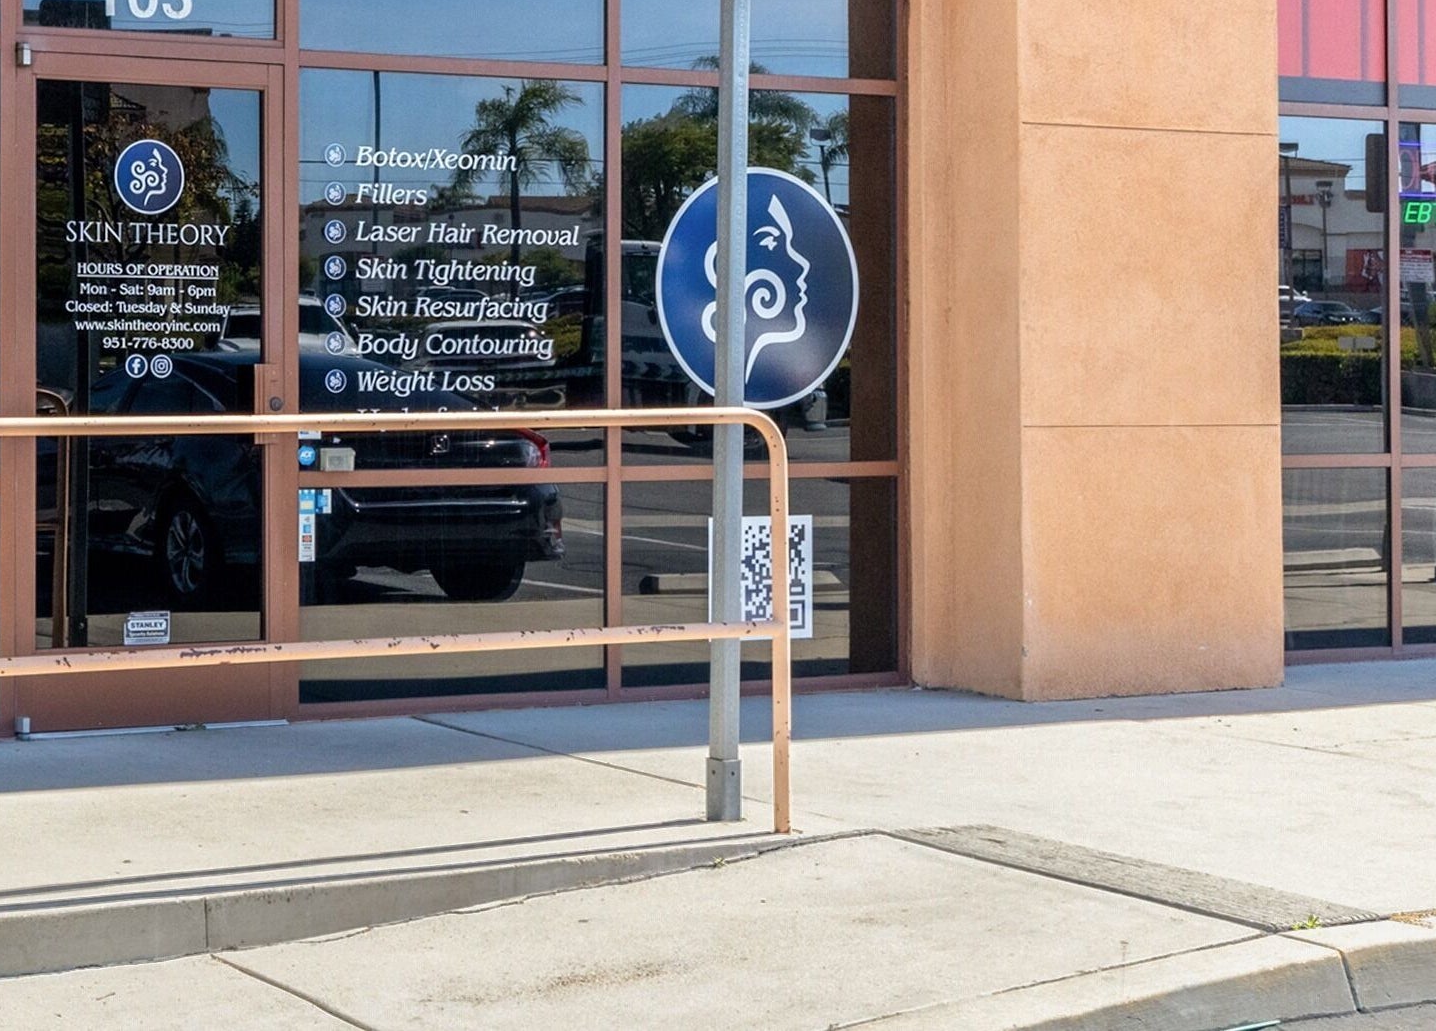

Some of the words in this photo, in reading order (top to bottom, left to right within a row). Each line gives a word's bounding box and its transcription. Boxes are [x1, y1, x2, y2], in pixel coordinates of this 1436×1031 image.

[355, 145, 517, 172] Botox/Xeomin
[355, 183, 427, 205] Fillers
[1404, 202, 1436, 224] EB
[65, 220, 122, 242] SKIN
[129, 222, 229, 245] THEORY
[355, 221, 421, 243] Laser
[427, 222, 475, 245] Hair
[481, 224, 579, 246] Removal
[77, 262, 123, 275] HOURS
[126, 263, 144, 276] OF
[147, 263, 220, 277] OPERATION
[355, 258, 407, 280] Skin
[414, 259, 536, 286] Tightening
[80, 283, 108, 295] Mon
[119, 283, 144, 296] Sat:
[147, 284, 175, 296] 9am
[187, 285, 217, 299] 6pm
[65, 300, 113, 314] Closed:
[116, 301, 167, 316] Tuesday
[170, 302, 182, 314] &
[184, 302, 230, 317] Sunday
[355, 295, 407, 317] Skin
[413, 296, 549, 323] Resurfacing
[75, 319, 221, 333] www.skintheoryinc.com
[103, 337, 194, 350] 951-776-8300
[356, 333, 419, 360] Body
[425, 334, 554, 359] Contouring
[357, 369, 436, 397] Weight
[440, 371, 495, 392] Loss
